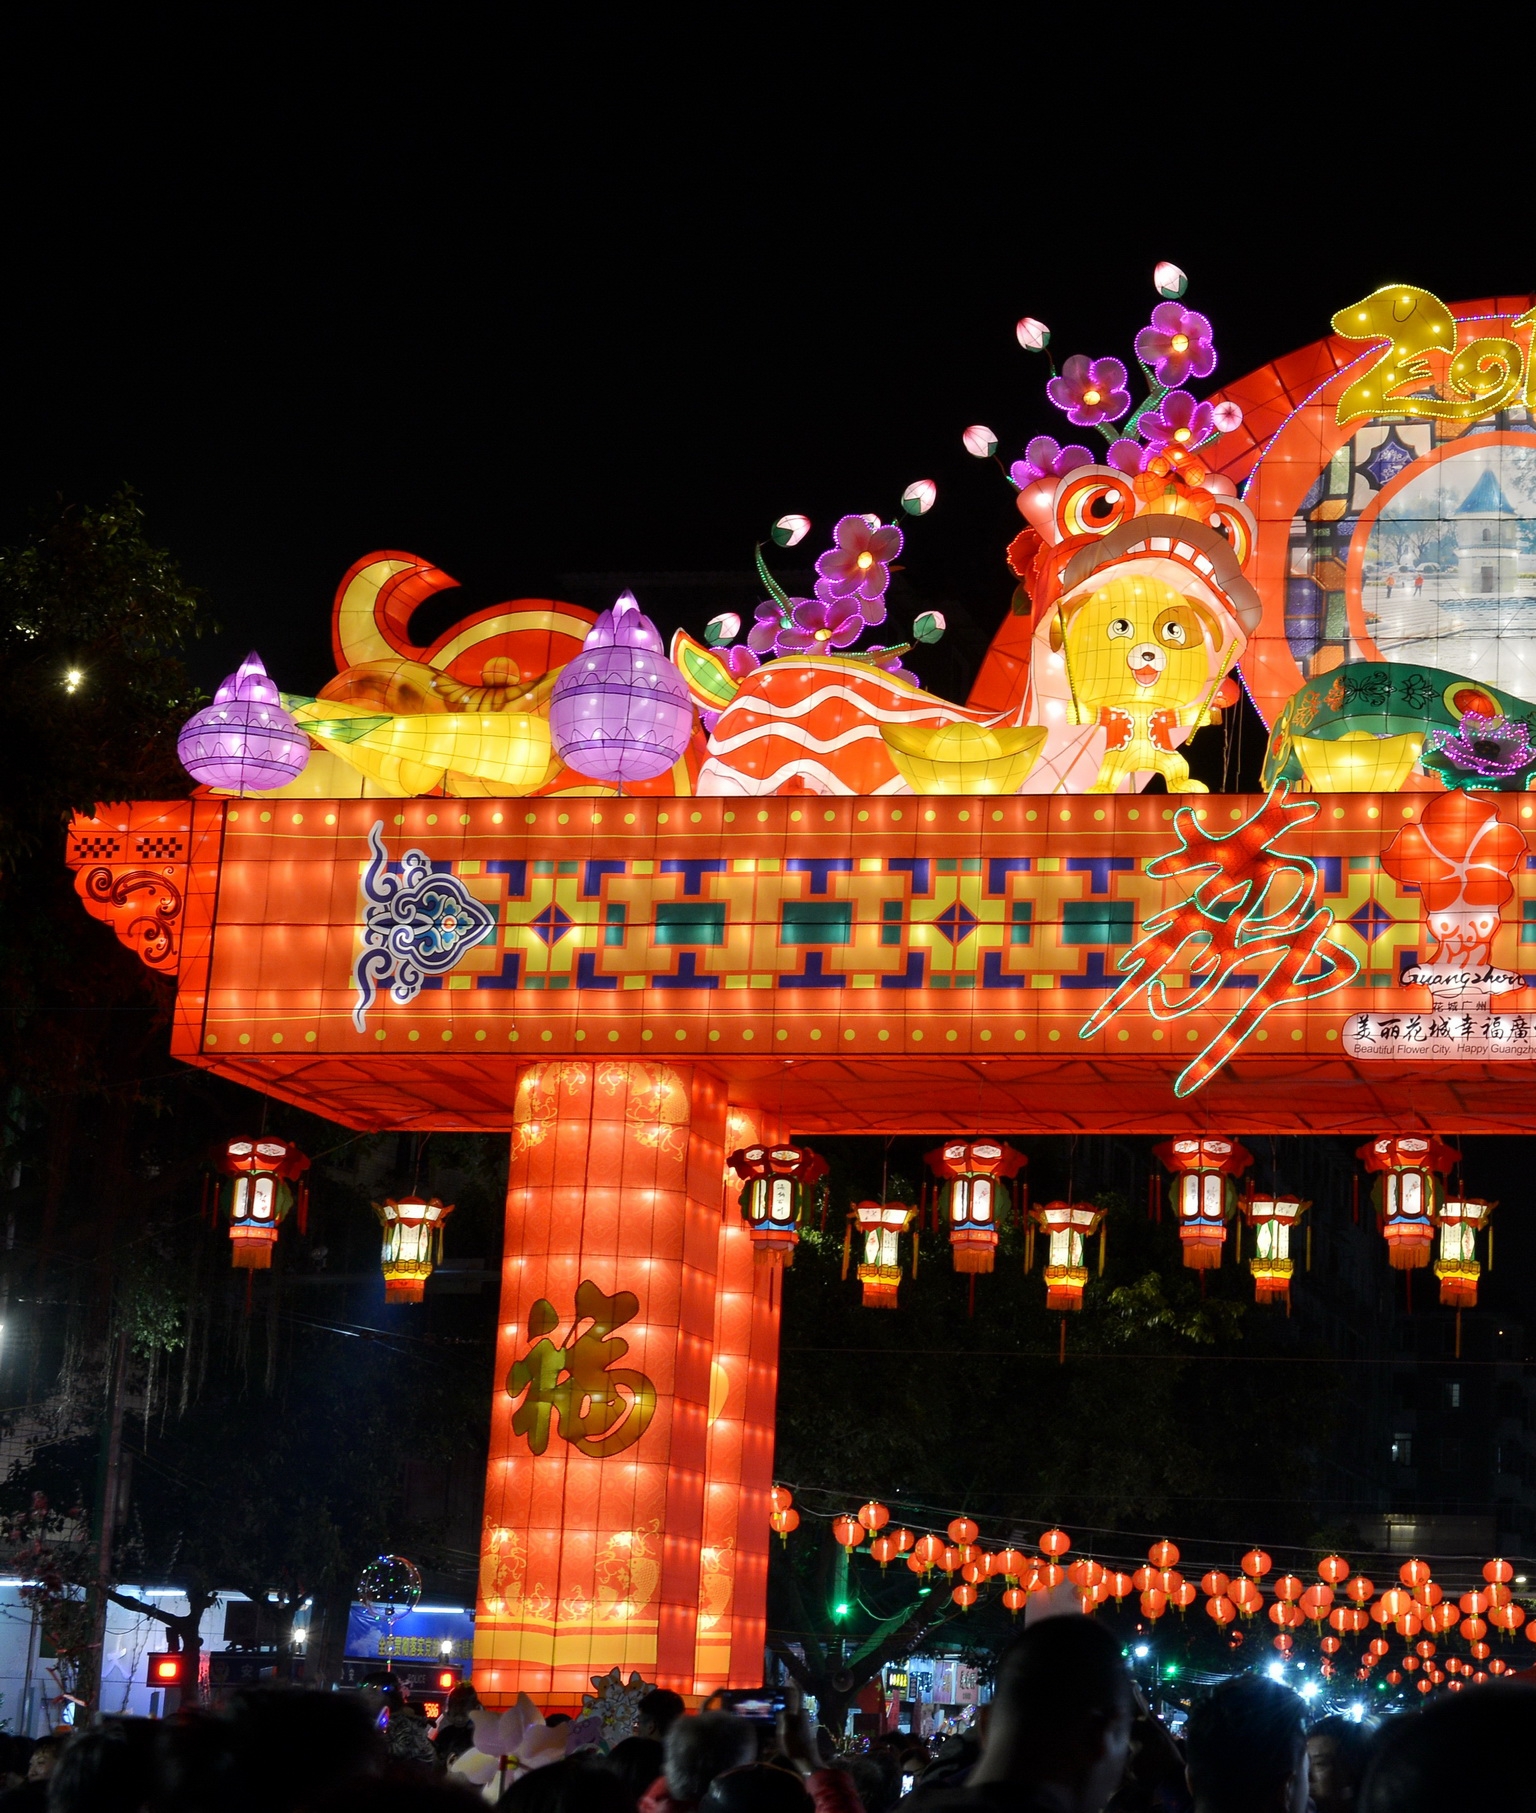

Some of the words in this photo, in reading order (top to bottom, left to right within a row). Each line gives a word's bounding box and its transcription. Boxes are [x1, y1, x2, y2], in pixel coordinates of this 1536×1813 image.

[1400, 963, 1529, 993] Guangzhou
[1353, 1043, 1395, 1055] Beautiful
[1397, 1043, 1429, 1055] Flower
[1431, 1043, 1452, 1055] City.
[1457, 1043, 1488, 1056] Happy
[505, 1279, 657, 1459] 福
